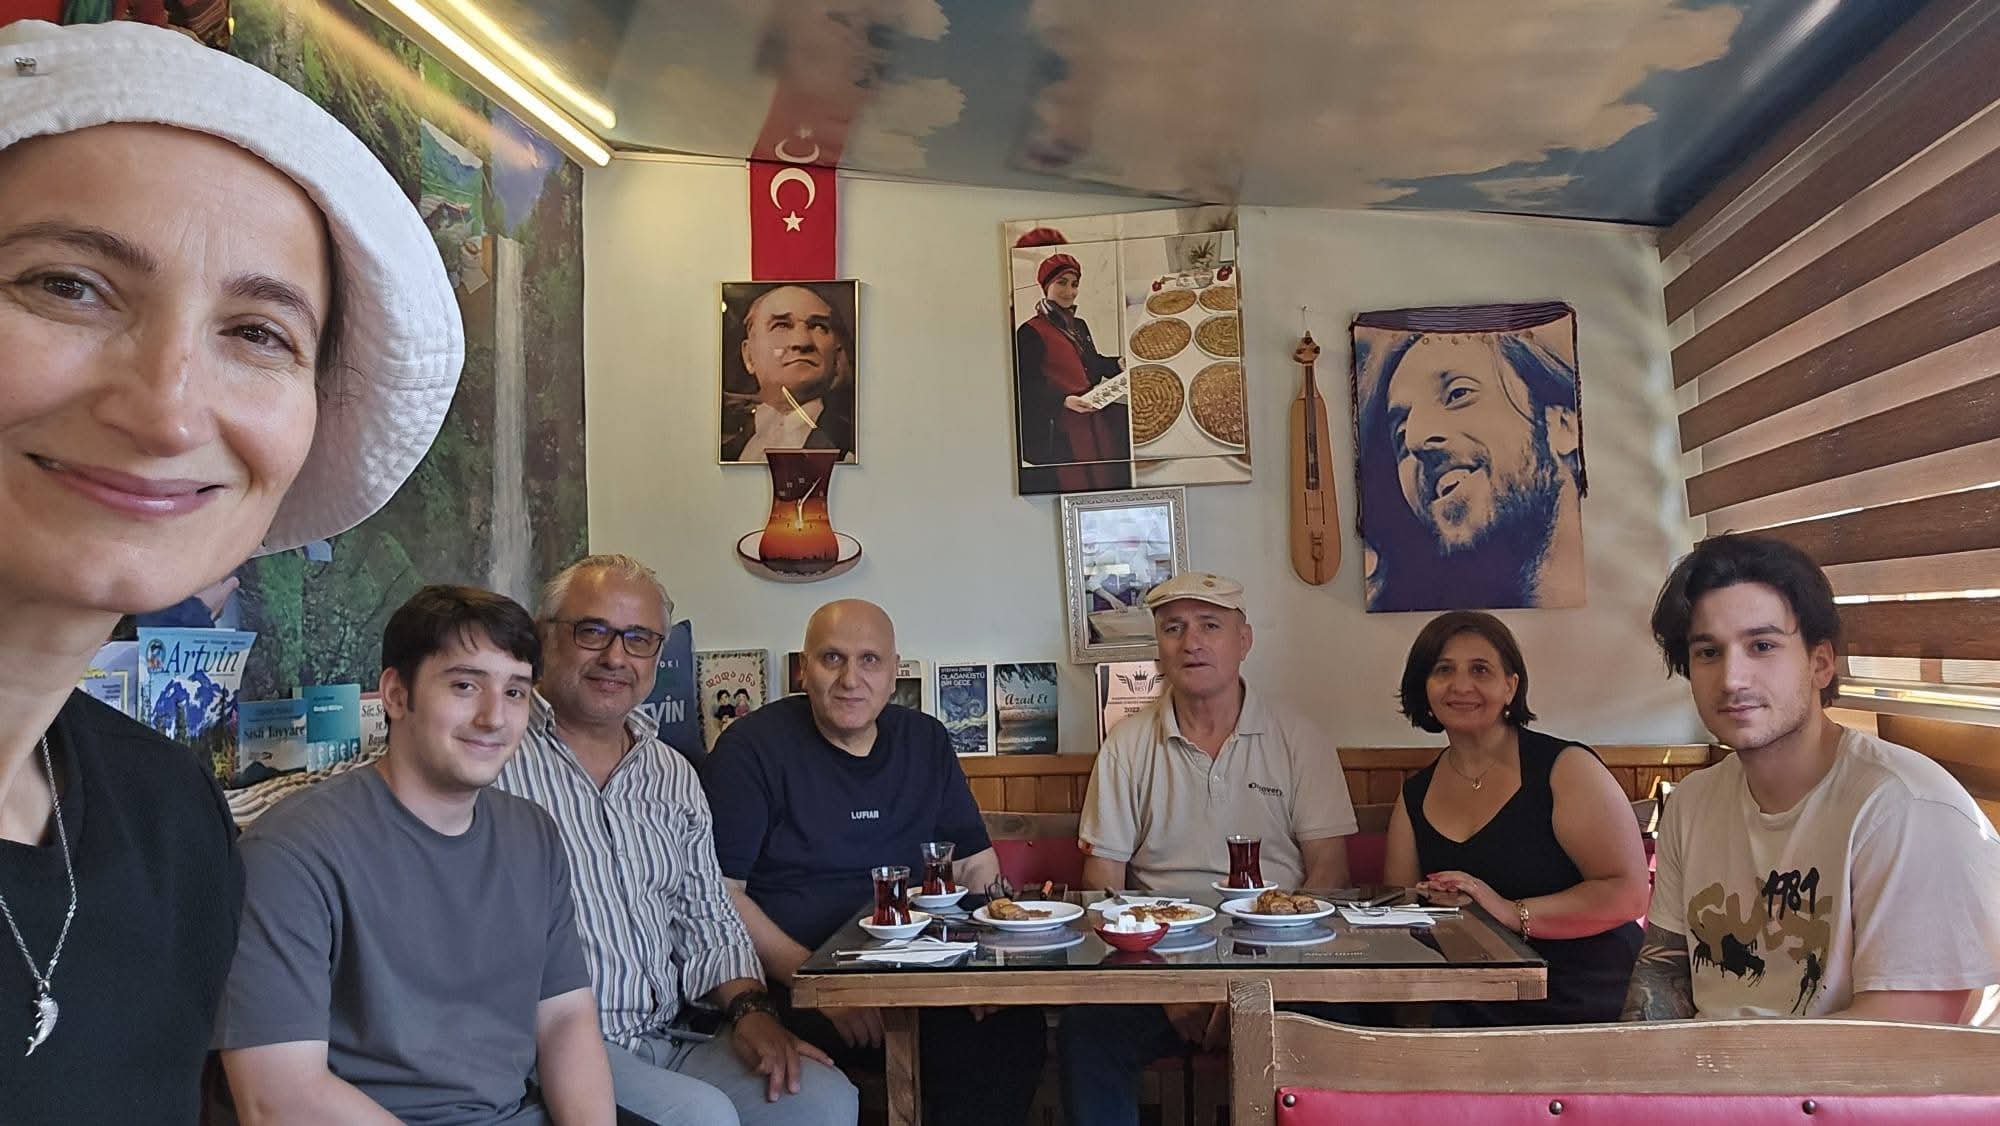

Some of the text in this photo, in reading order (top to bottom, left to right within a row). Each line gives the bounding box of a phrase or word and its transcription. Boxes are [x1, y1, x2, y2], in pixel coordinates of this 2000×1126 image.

[163, 641, 240, 673] Artvin
[850, 810, 880, 819] LUFIAN
[1761, 867, 1820, 920] 1981
